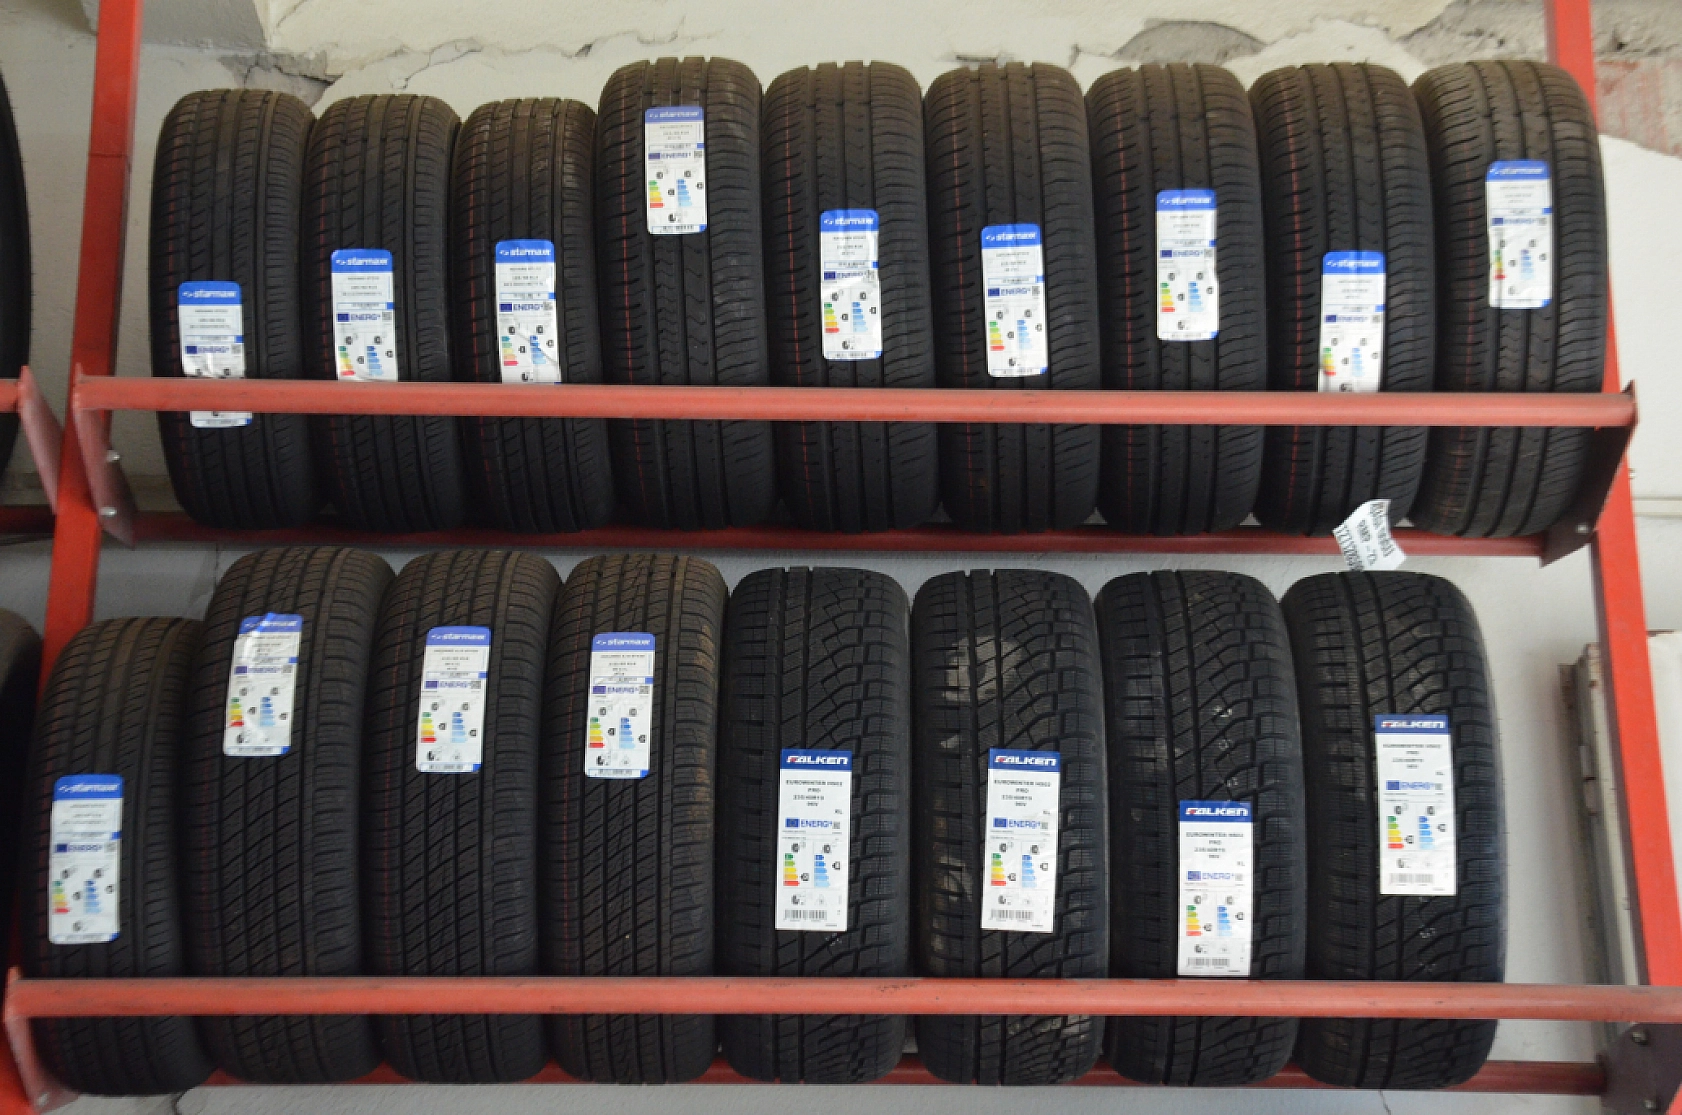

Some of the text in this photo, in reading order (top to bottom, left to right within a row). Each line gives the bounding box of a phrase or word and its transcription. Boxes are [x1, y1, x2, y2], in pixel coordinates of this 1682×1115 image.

[1381, 721, 1446, 729] FALKEN
[786, 756, 848, 765] FALKEN
[994, 755, 1057, 766] FALKEN
[1185, 807, 1249, 817] FALKEN
